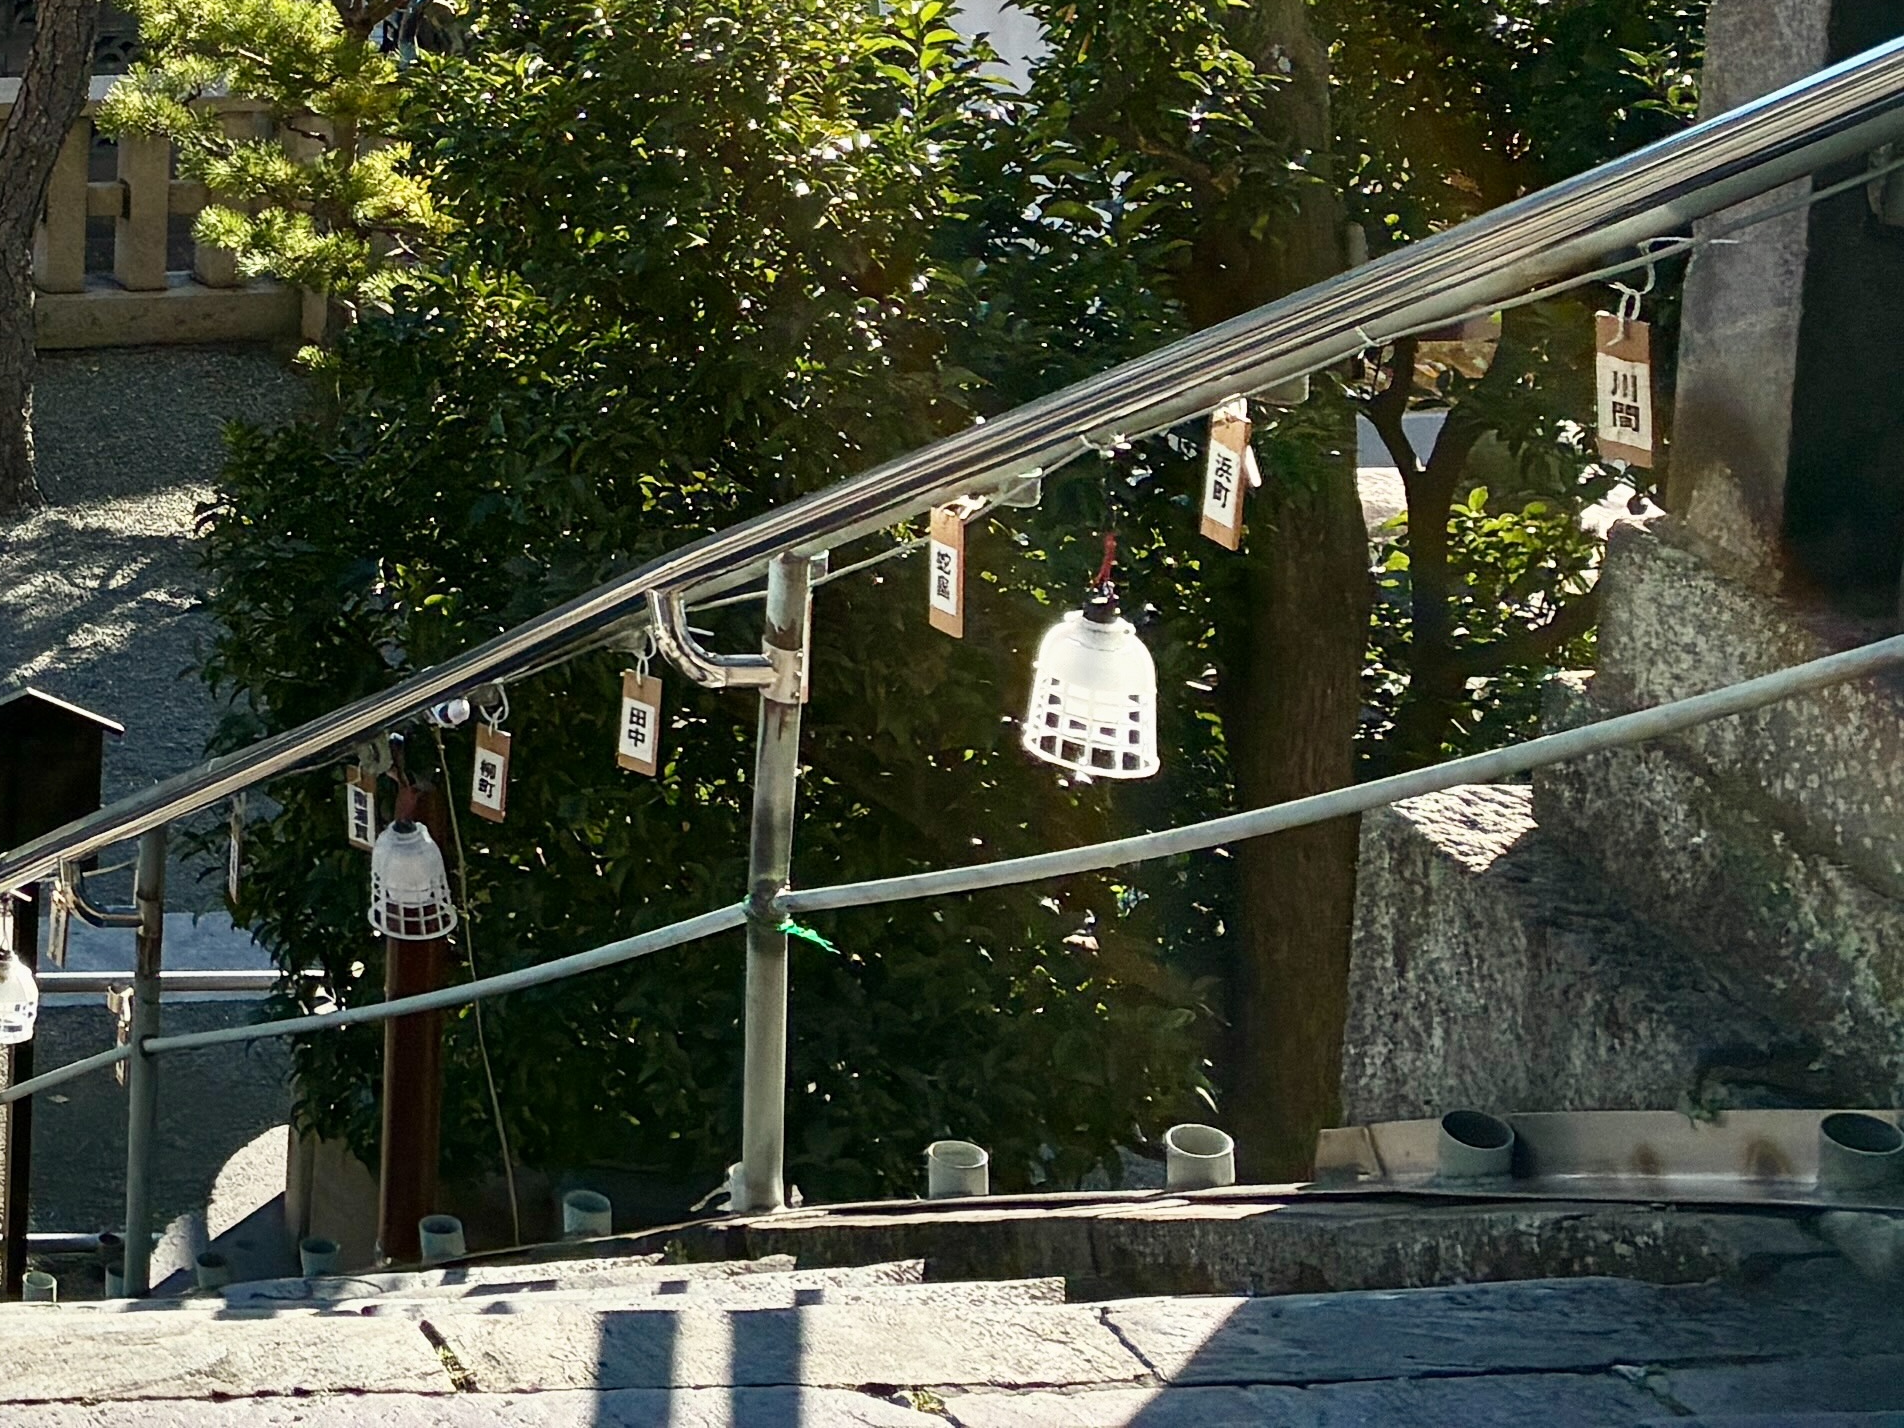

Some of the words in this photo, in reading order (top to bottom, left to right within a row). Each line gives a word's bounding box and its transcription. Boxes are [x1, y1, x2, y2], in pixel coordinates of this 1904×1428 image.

[1610, 370, 1640, 433] 川間
[1212, 452, 1233, 509] 浜町
[627, 706, 648, 748] 田中
